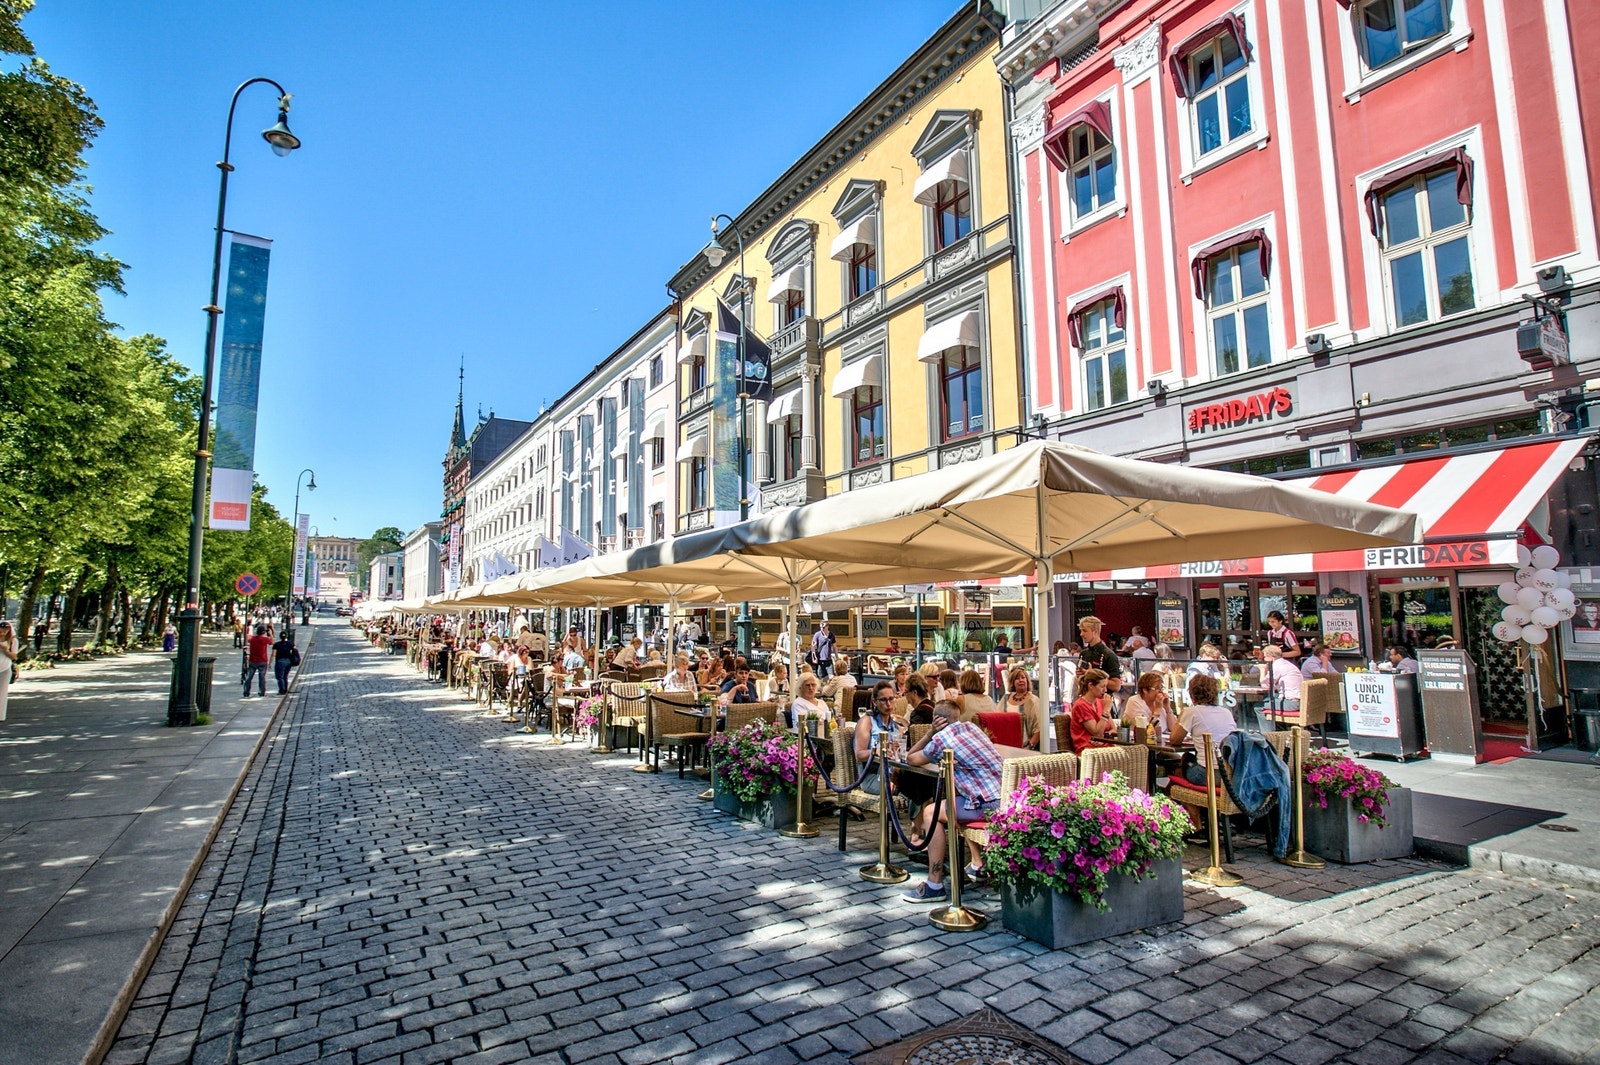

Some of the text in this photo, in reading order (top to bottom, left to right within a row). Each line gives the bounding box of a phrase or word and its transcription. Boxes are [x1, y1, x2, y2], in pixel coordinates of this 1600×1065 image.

[1367, 542, 1488, 567] TGI FRIDAYS
[1179, 558, 1249, 575] FRIDAYS
[1326, 620, 1353, 628] CHICKEN
[1354, 683, 1385, 694] LUNCH
[1358, 694, 1382, 704] DEAL
